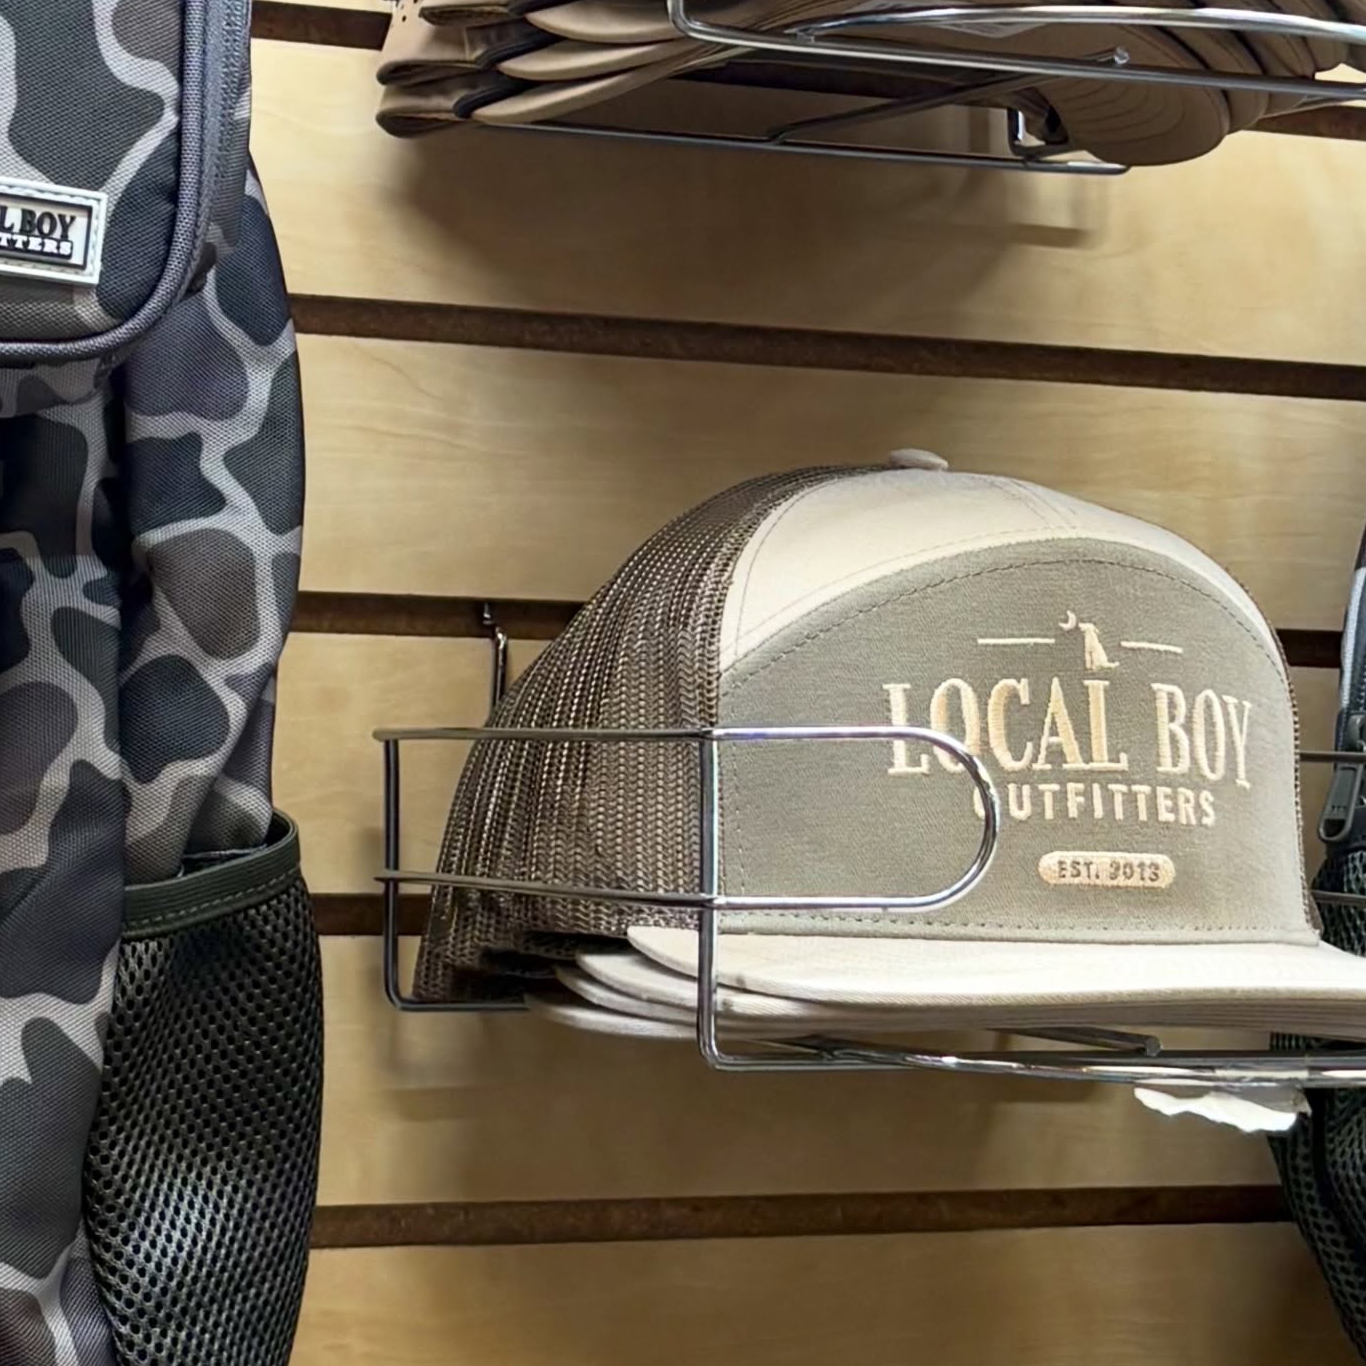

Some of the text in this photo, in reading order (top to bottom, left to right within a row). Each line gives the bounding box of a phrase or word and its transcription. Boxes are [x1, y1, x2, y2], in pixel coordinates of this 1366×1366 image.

[19, 208, 76, 239] BOY
[882, 677, 1251, 789] LOCAL BOY
[1057, 860, 1099, 880] EST.
